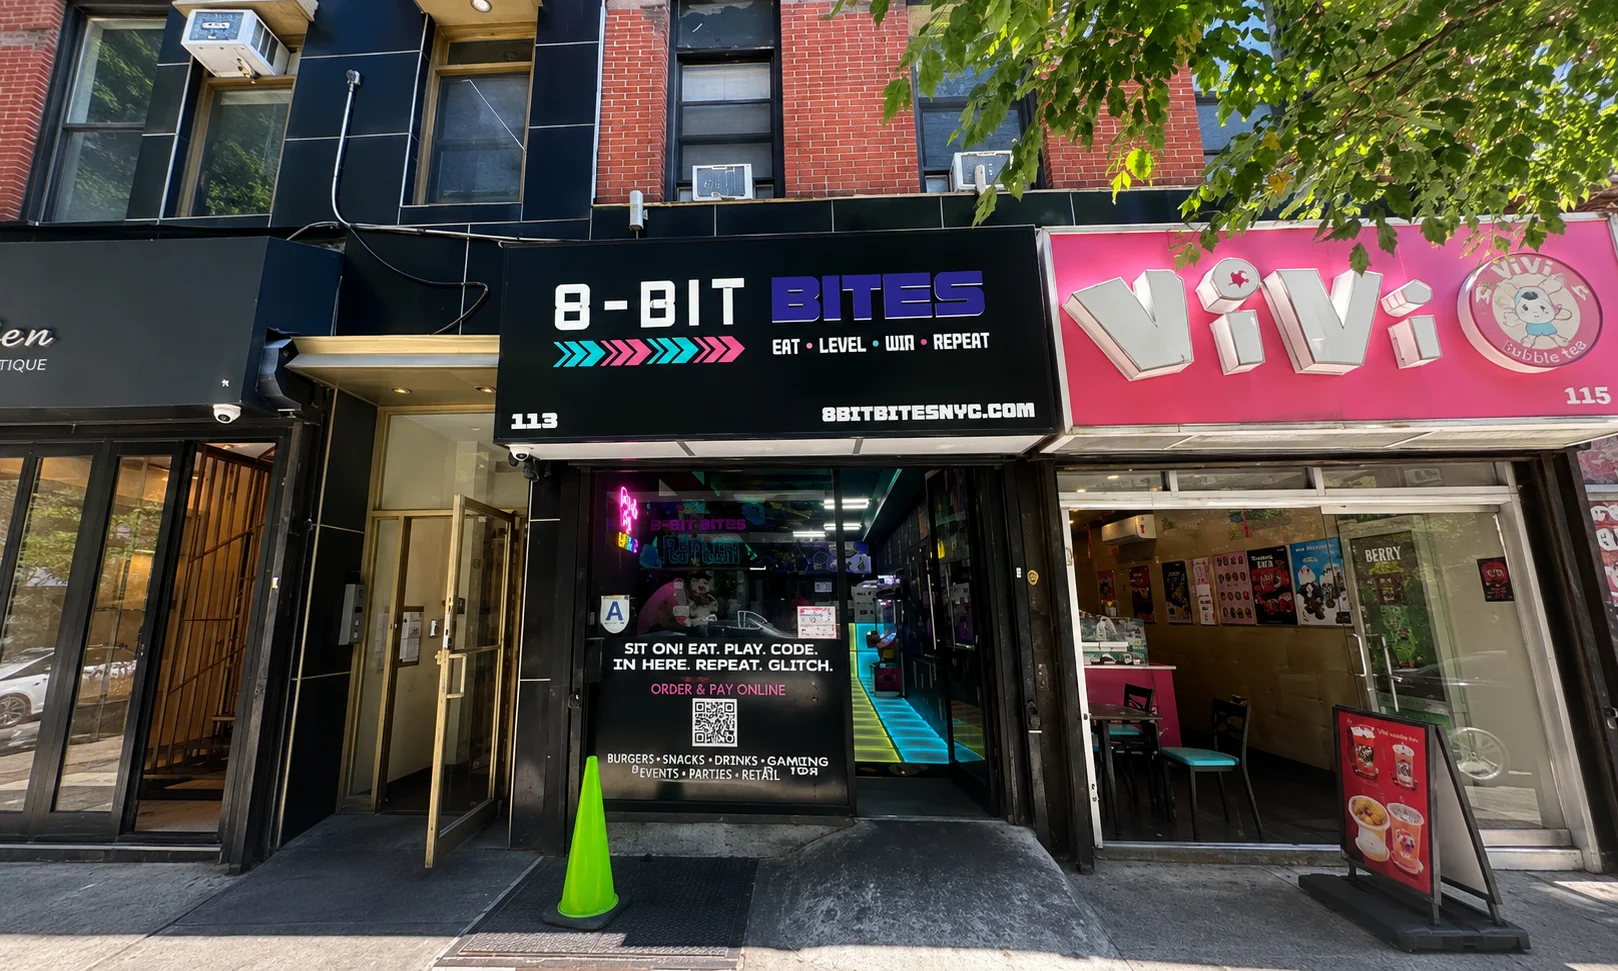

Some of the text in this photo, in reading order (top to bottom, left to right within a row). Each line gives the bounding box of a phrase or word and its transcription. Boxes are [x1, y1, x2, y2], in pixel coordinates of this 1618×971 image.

[1491, 256, 1553, 280] ViVi
[554, 270, 986, 331] 8-BIT BITES
[1062, 256, 1442, 382] ViVi
[0, 328, 54, 347] en
[772, 338, 800, 356] EAT
[819, 336, 867, 354] LEVEL
[933, 332, 990, 350] REPEAT
[1562, 340, 1587, 359] tea
[0, 358, 47, 373] TIQUE
[1564, 386, 1612, 405] 115
[511, 412, 558, 430] 113
[822, 402, 1035, 423] 8BITBITESNYC.COM
[699, 518, 747, 531] BITES
[1365, 546, 1401, 563] BERRY
[605, 600, 624, 621] A
[624, 642, 818, 656] SIT ON! EAT. PLAY. CODE.
[613, 658, 834, 672] IN HERE. REPEAT. GLITCH.
[650, 683, 786, 696] ORDER & PAY ONLINE
[607, 753, 654, 764] BURGERS
[662, 754, 705, 765] SNACKS
[714, 755, 758, 766] DRINKS
[640, 767, 679, 779] EVENTS
[689, 768, 732, 780] PARTIES
